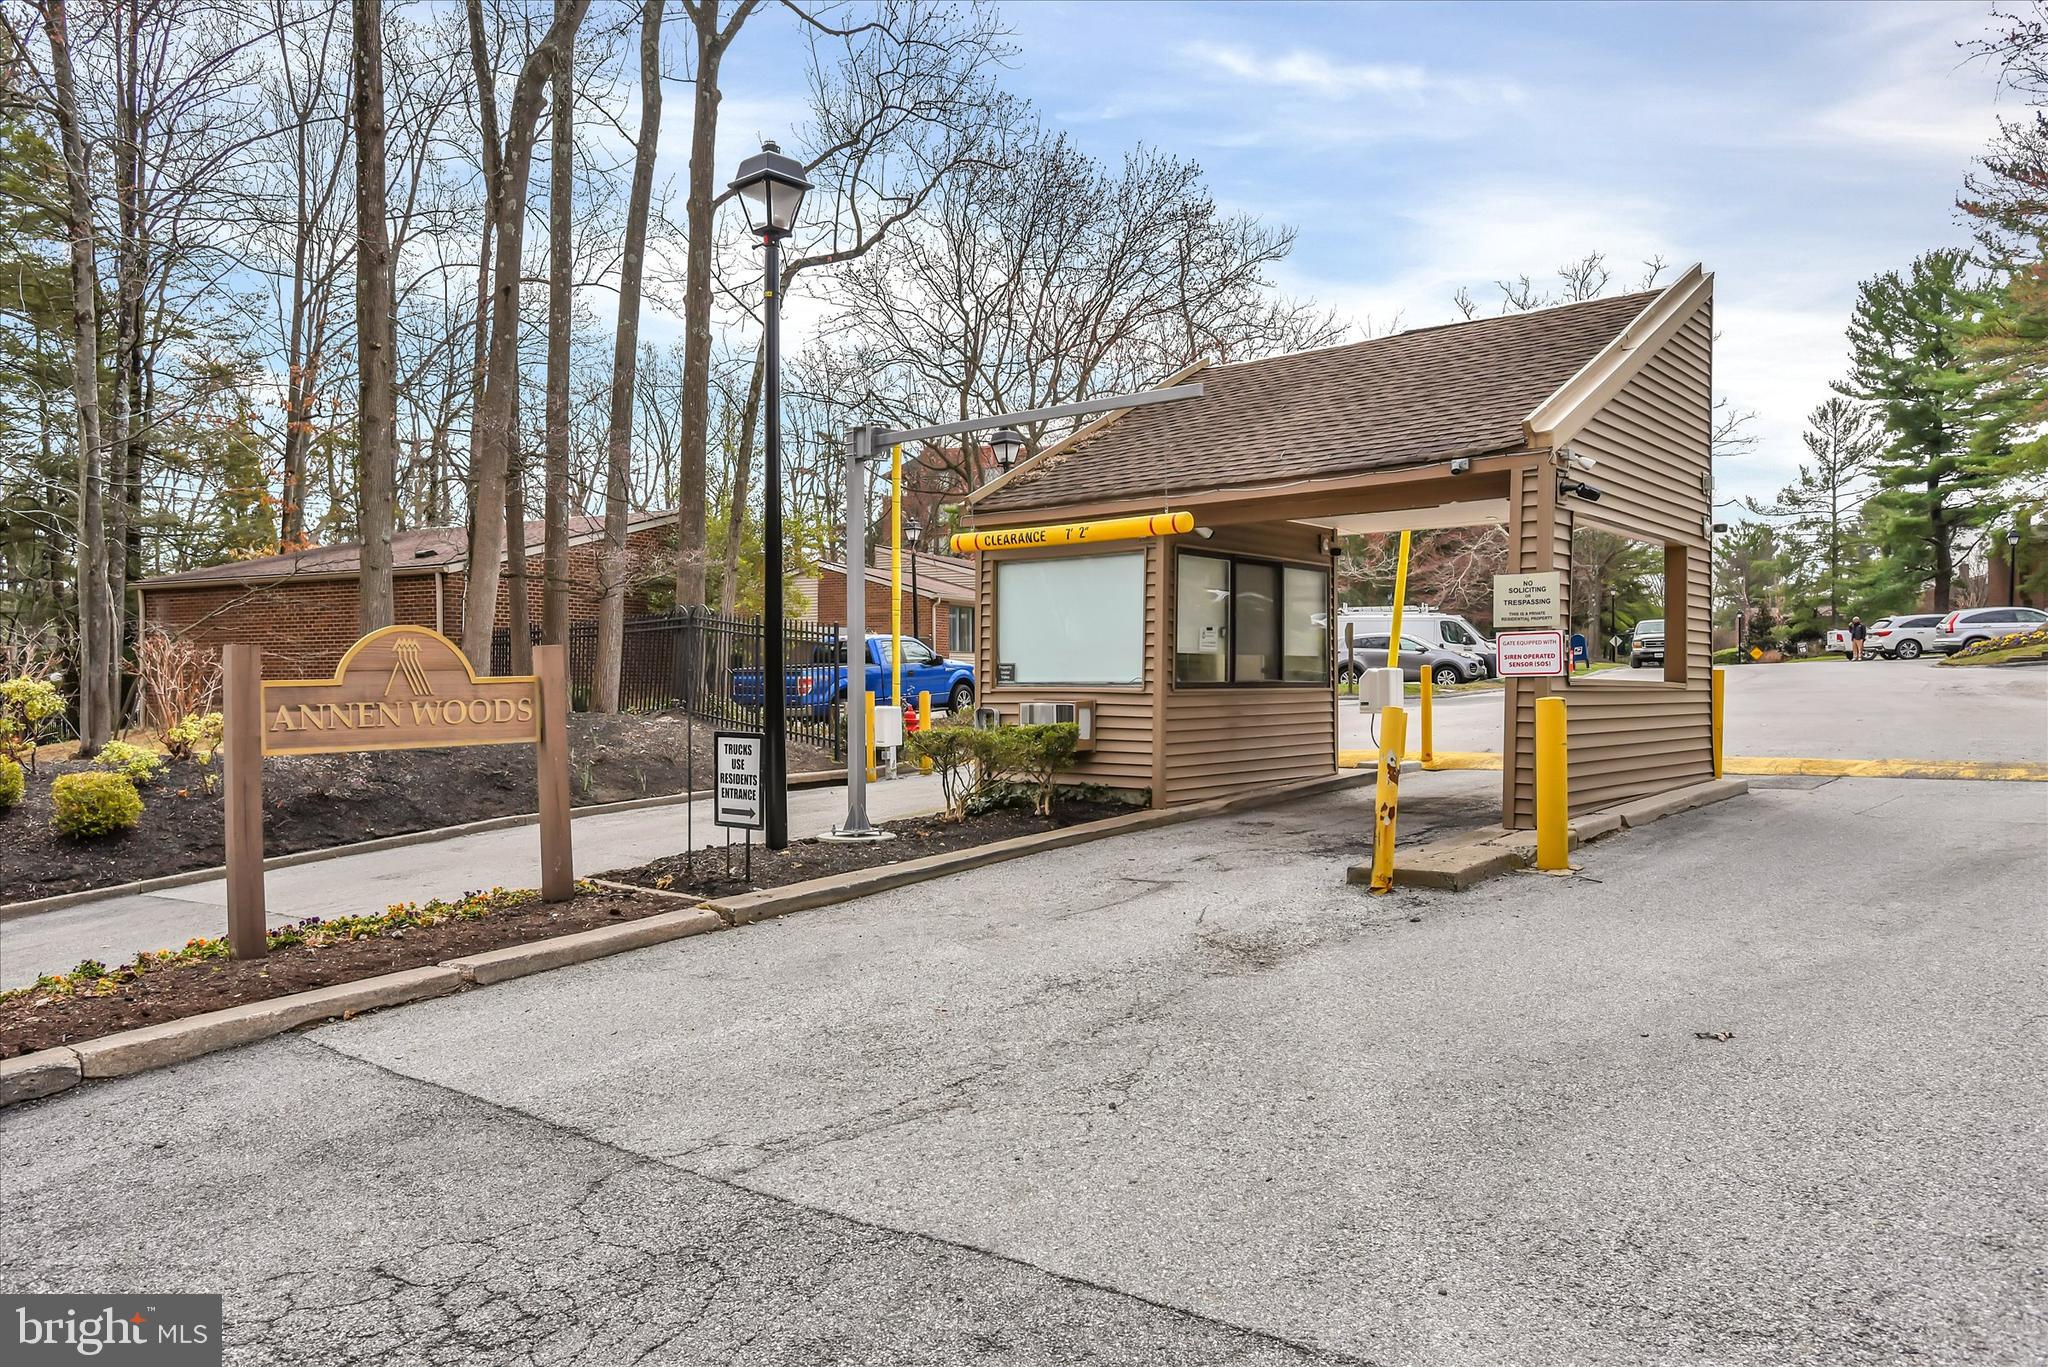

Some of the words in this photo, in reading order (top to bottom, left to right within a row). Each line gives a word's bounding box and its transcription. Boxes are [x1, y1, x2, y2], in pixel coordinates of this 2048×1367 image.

[984, 531, 1046, 546] CLEARANCE
[1066, 528, 1073, 540] 7'
[270, 702, 400, 732] ANNEN
[410, 697, 532, 726] WOODS
[724, 744, 752, 756] TRUCKS
[732, 759, 744, 770] USE
[720, 773, 757, 786] RESIDENTS
[721, 788, 756, 800] ENTRANCE
